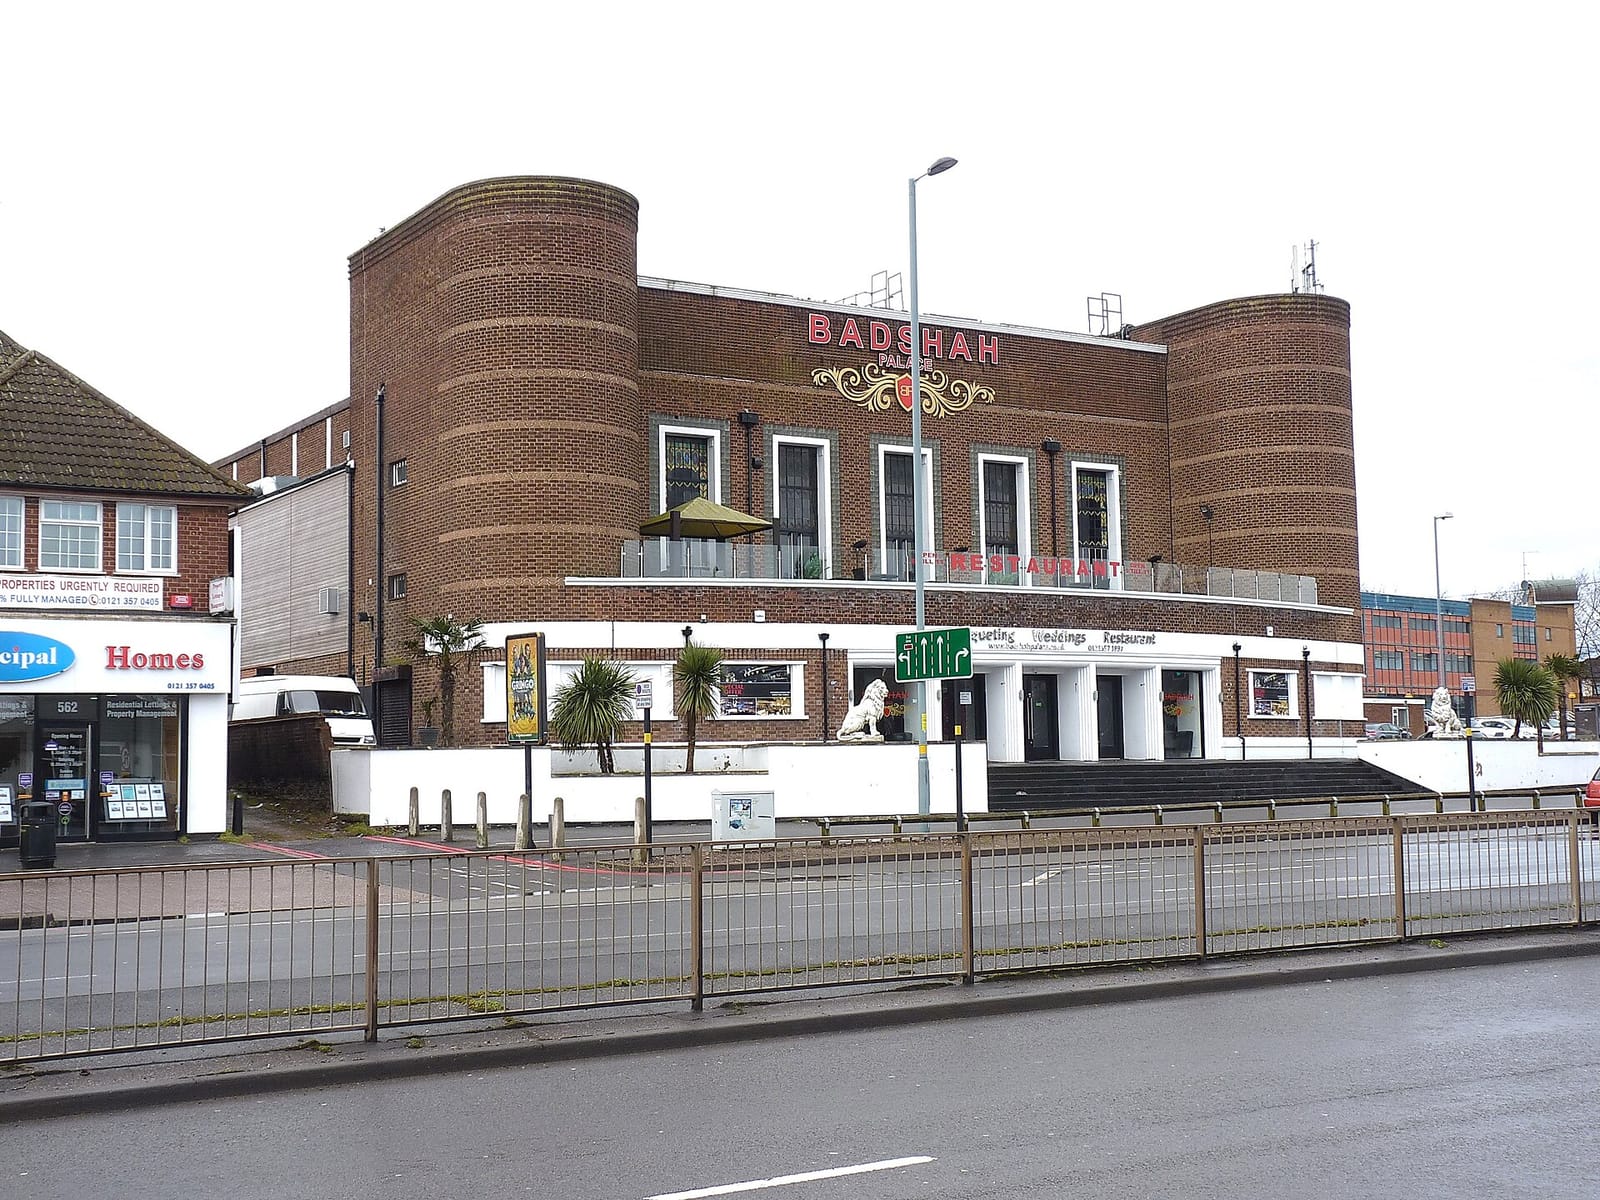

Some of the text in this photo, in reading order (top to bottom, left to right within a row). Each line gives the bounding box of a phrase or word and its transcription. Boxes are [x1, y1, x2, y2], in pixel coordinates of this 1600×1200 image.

[808, 313, 999, 364] BADSHAH
[950, 553, 1120, 577] RESTAURANT
[0, 579, 160, 593] ROPERTIES URGENTLY REQUIRED
[10, 594, 39, 603] FULLY
[41, 595, 87, 604] MANAGED
[123, 597, 138, 606] 357
[140, 598, 160, 606] 0405
[1032, 629, 1086, 646] Weddings
[1103, 631, 1156, 645] Restaurant
[106, 646, 204, 670] Homes
[57, 701, 79, 713] 562
[106, 701, 143, 709] Residential
[144, 701, 171, 709] Lettings
[106, 710, 177, 719] Property Management
